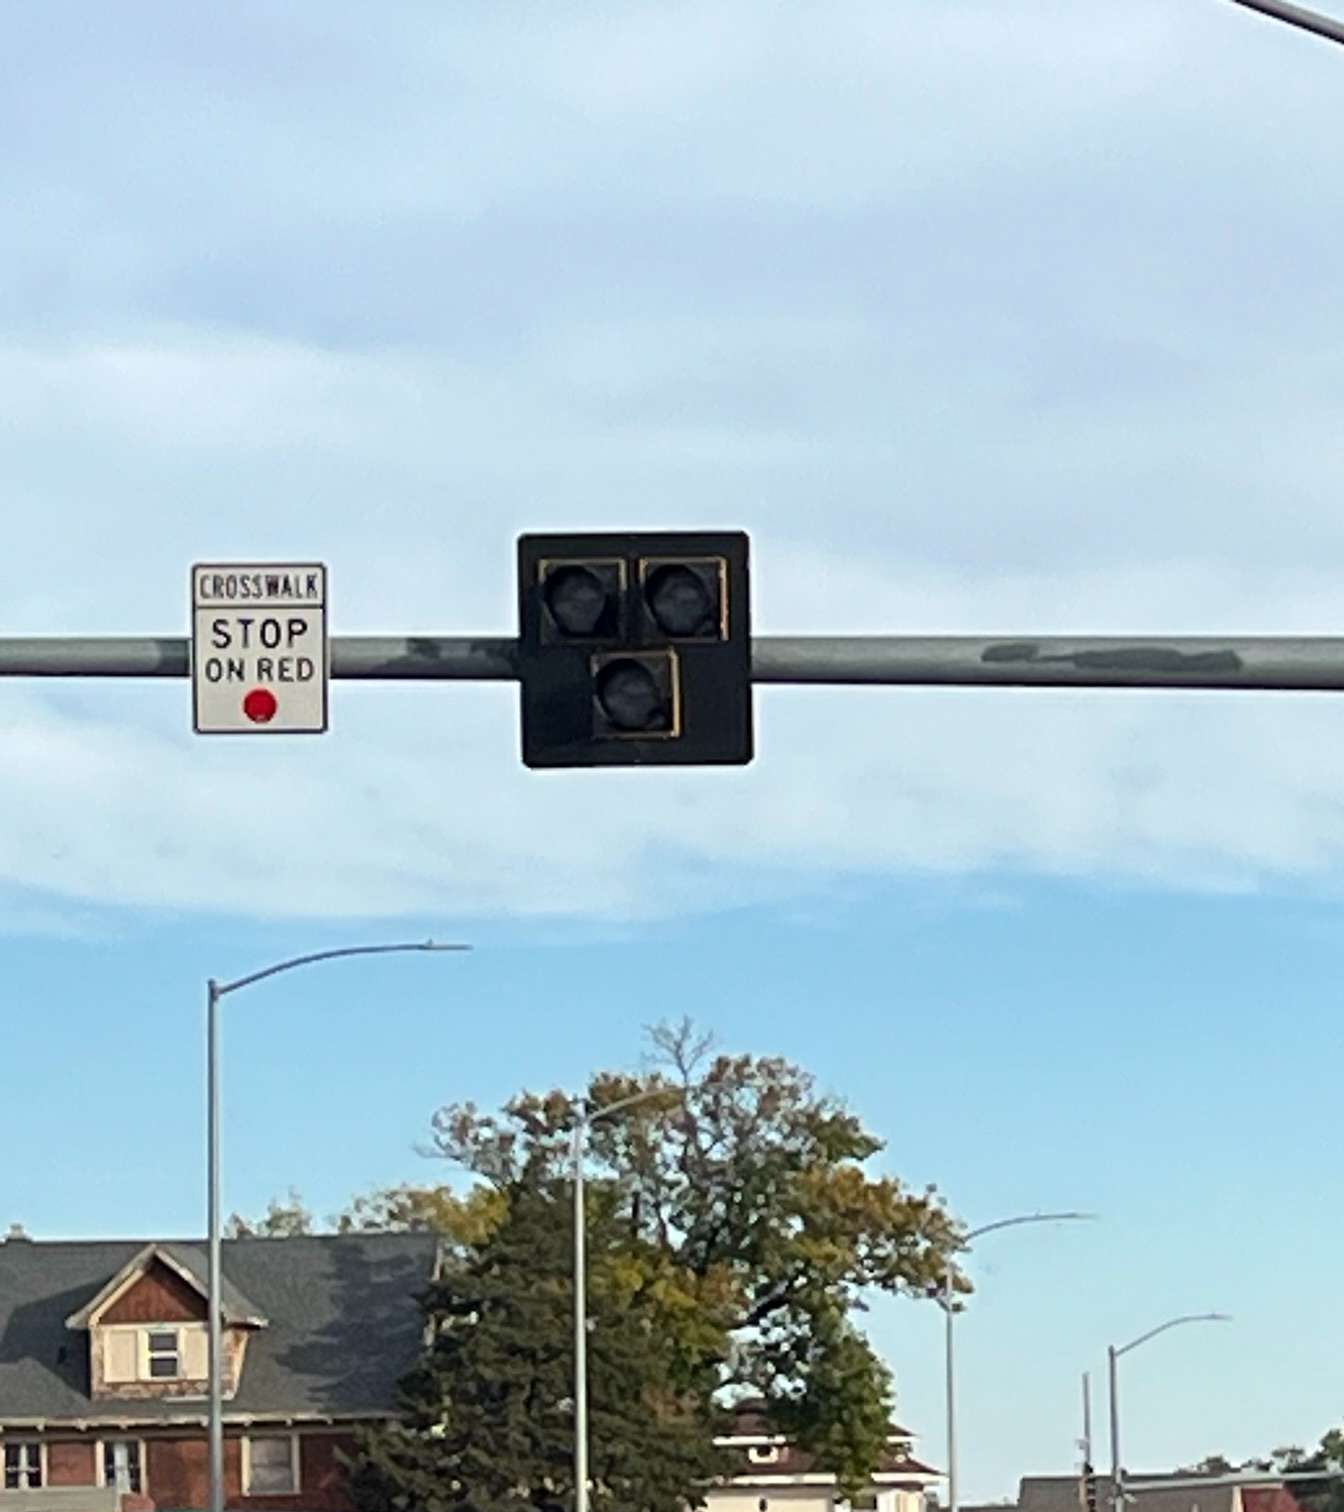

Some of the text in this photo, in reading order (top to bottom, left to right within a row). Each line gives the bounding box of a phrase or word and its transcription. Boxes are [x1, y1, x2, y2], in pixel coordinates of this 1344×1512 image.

[200, 573, 318, 599] CROSSWALK
[211, 618, 308, 649] STOP
[205, 657, 315, 683] ON RED
